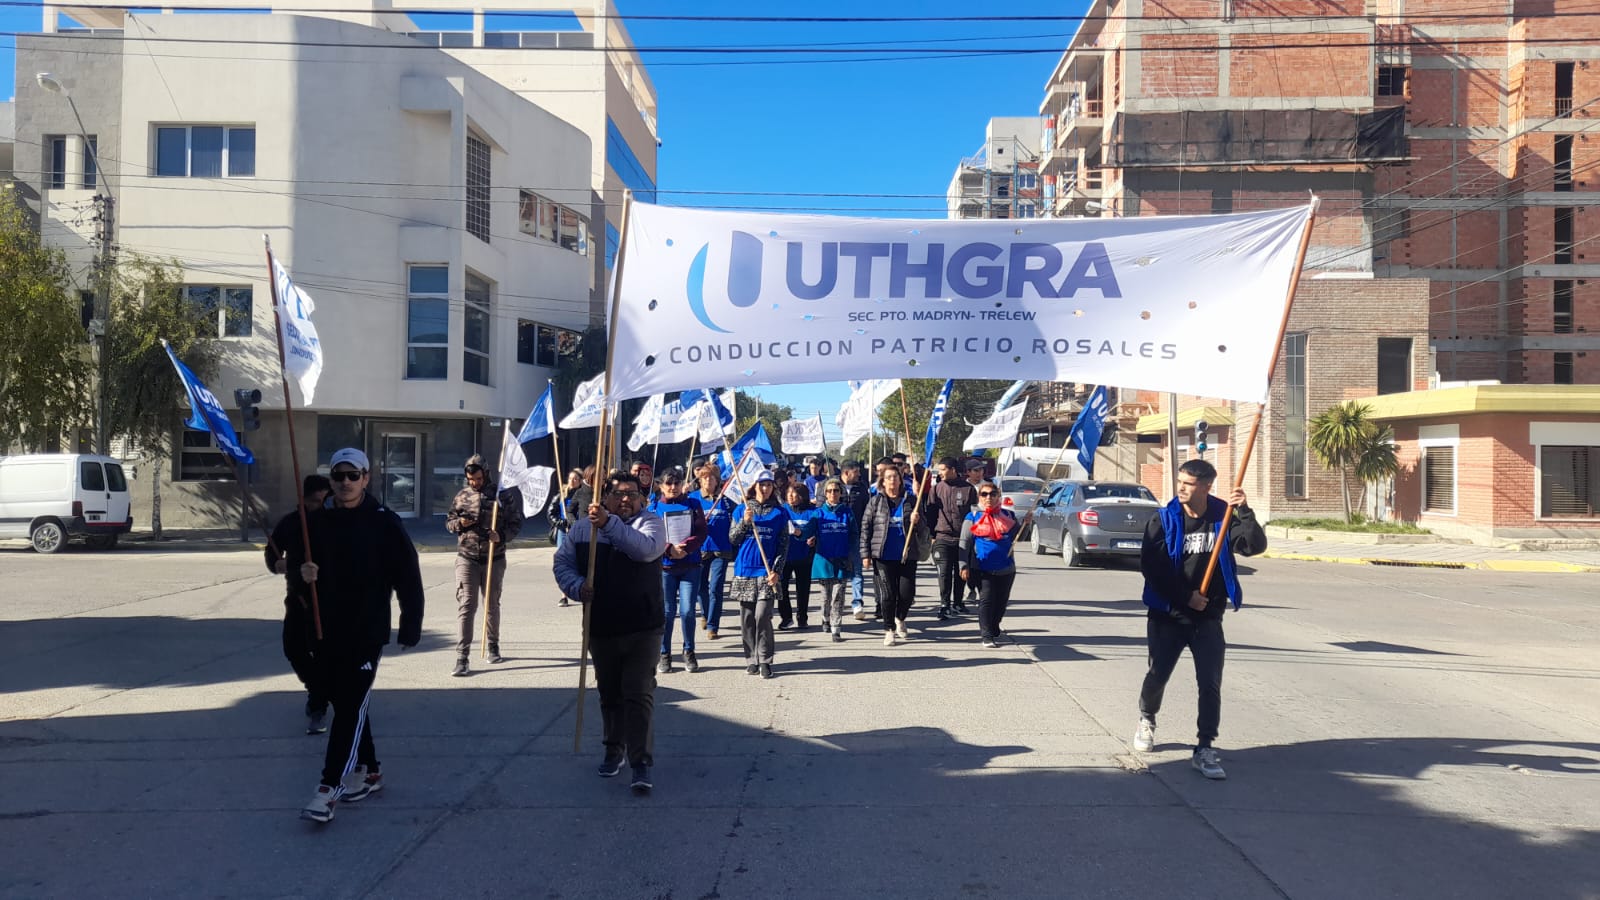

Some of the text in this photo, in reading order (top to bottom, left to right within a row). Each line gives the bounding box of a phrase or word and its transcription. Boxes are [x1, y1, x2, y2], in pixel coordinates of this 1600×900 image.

[786, 242, 1121, 300] UTHGRA
[880, 311, 909, 321] PTO.
[979, 311, 1037, 321] TRELEW
[670, 337, 1177, 364] CONDUCCION PATRICIO ROSALES
